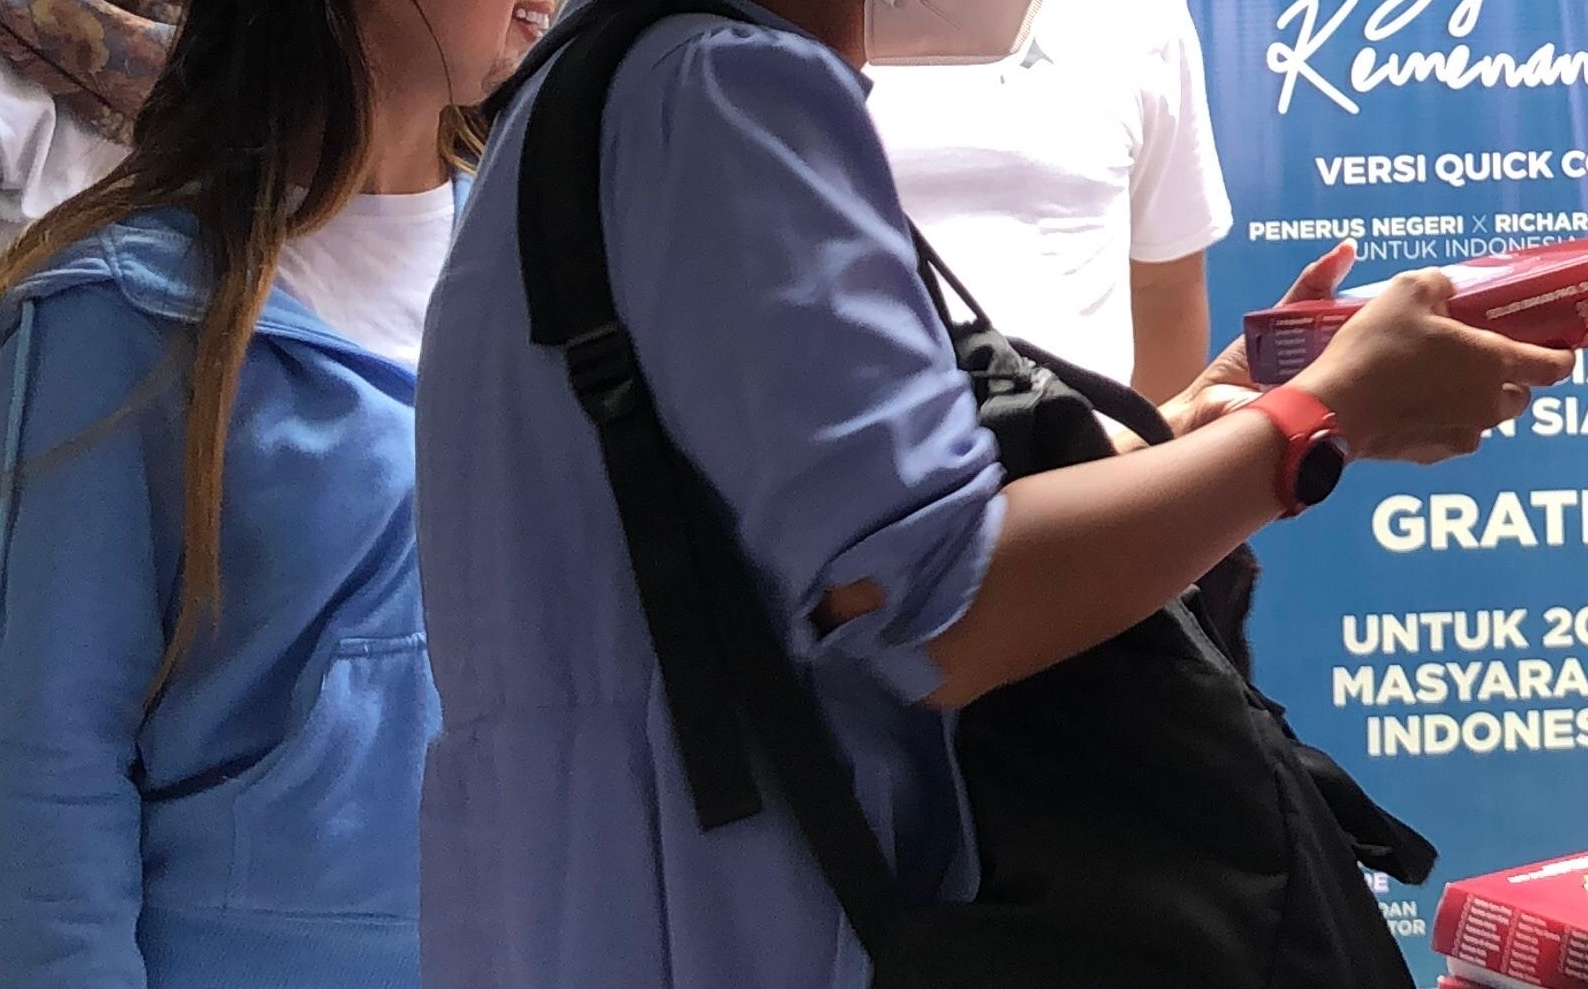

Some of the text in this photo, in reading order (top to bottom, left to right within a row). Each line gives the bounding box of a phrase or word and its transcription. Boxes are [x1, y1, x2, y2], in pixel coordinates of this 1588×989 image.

[1315, 153, 1427, 186] VERSI
[1435, 149, 1554, 187] QUICK
[1248, 218, 1366, 242] PENERUS
[1371, 214, 1465, 238] NEGERI
[1355, 240, 1438, 262] UNTUK
[1341, 608, 1530, 656] UNTUK
